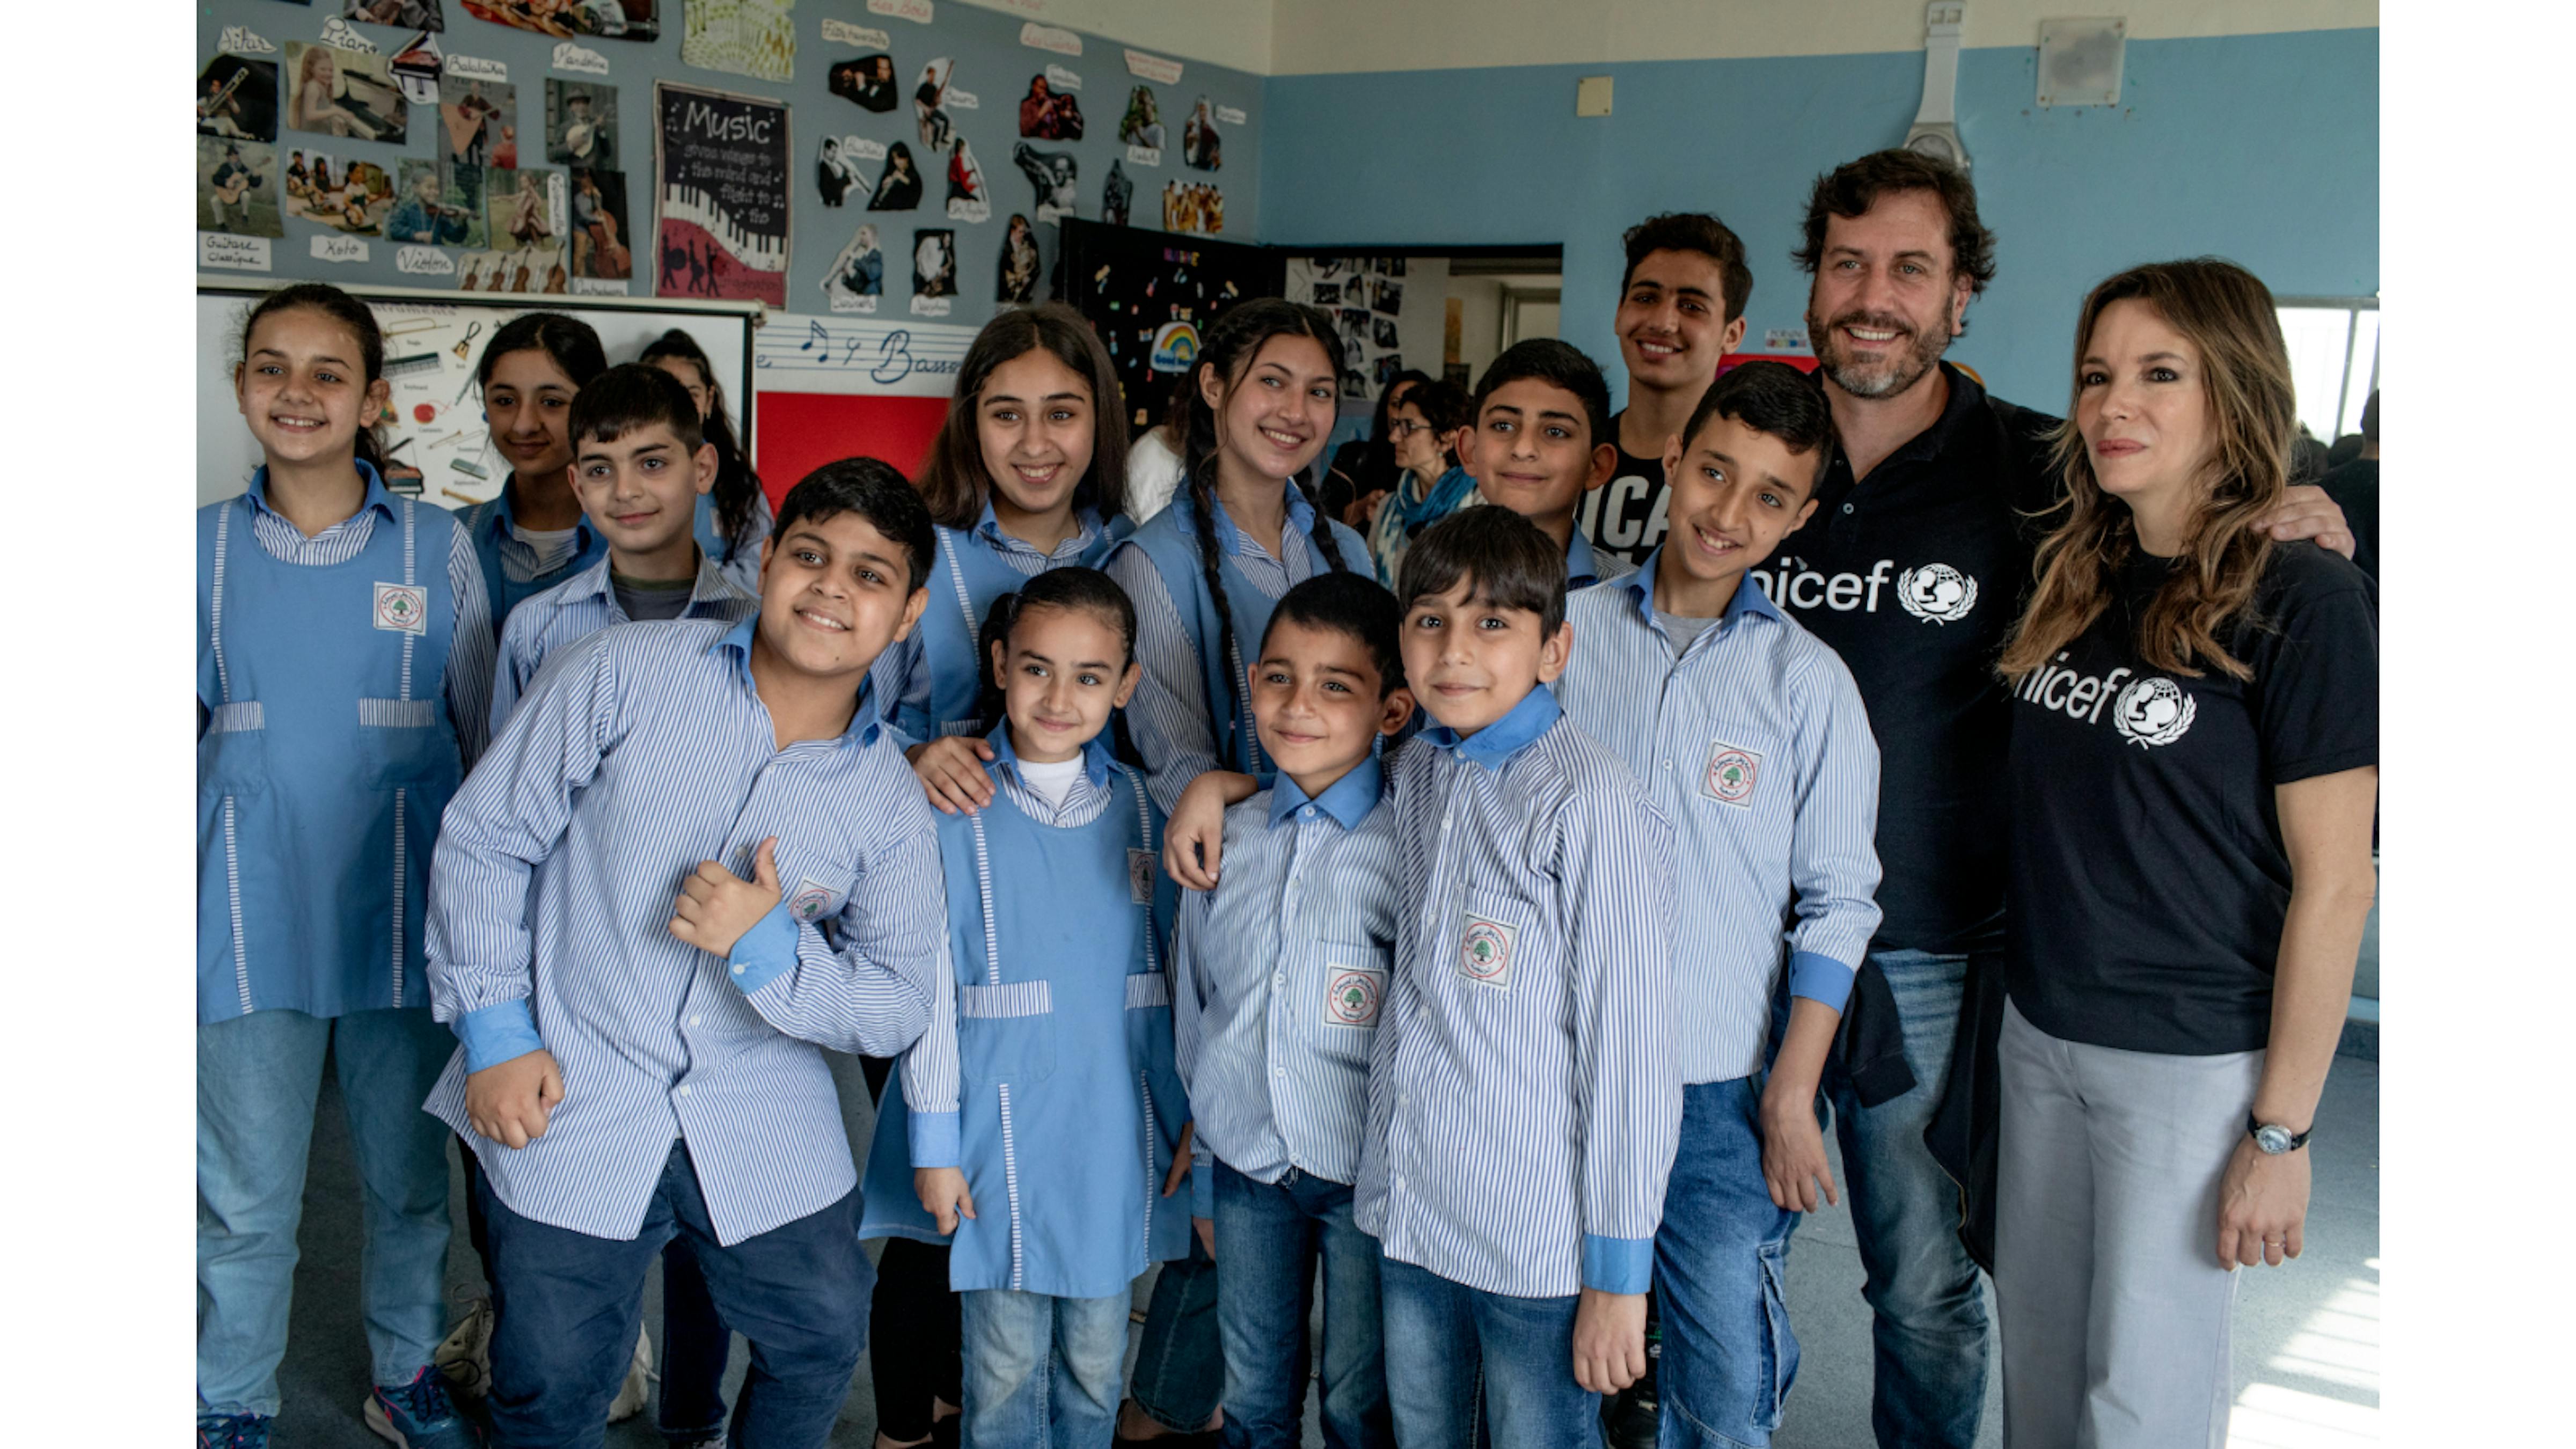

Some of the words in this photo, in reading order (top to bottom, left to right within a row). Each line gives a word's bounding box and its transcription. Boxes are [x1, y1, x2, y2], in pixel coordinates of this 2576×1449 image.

[320, 18, 378, 54] Piano
[683, 100, 771, 144] Music
[1573, 475, 1672, 548] ICA
[1750, 556, 1894, 612] nicef
[2014, 652, 2132, 724] nicef
